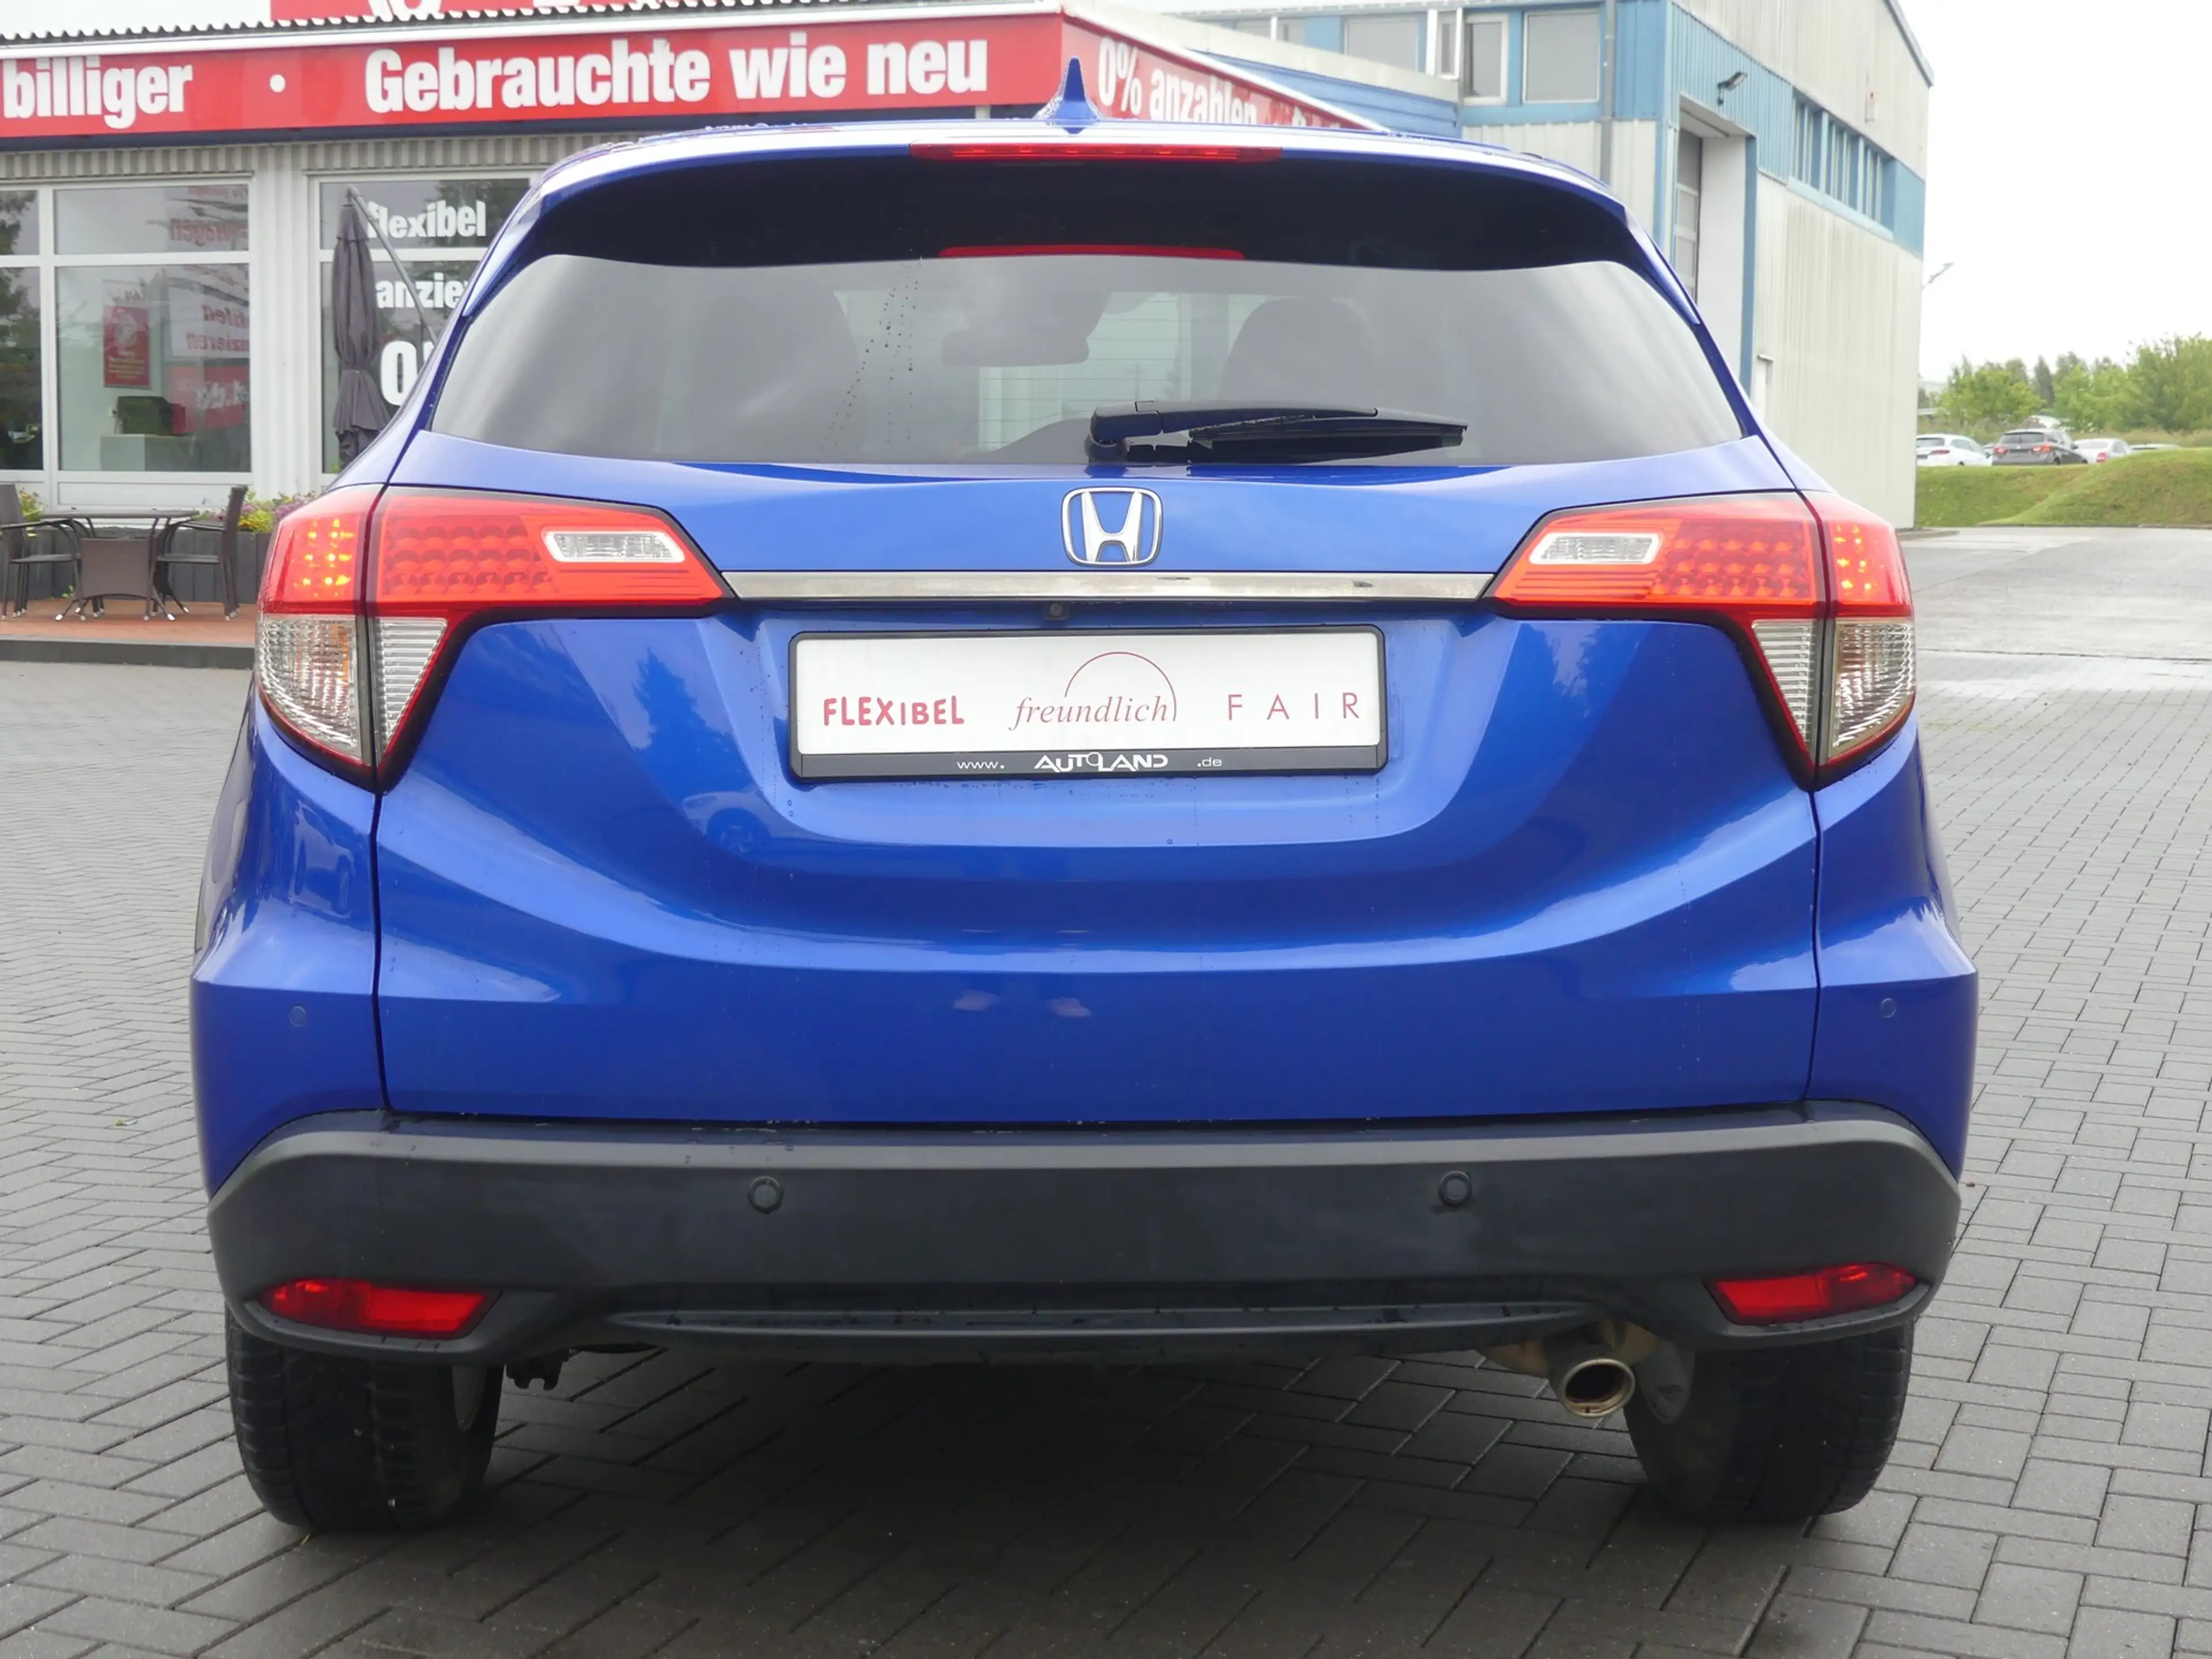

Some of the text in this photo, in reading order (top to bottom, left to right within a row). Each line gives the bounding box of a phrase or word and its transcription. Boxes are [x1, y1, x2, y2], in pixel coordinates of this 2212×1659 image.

[3, 55, 193, 129] billiger
[365, 31, 987, 114] Gebrauchte wie neu
[1099, 36, 1142, 116] 0%
[823, 691, 1359, 731] FLEXIBEL freundlich FAIR
[1034, 751, 1168, 772] AUTOLAND
